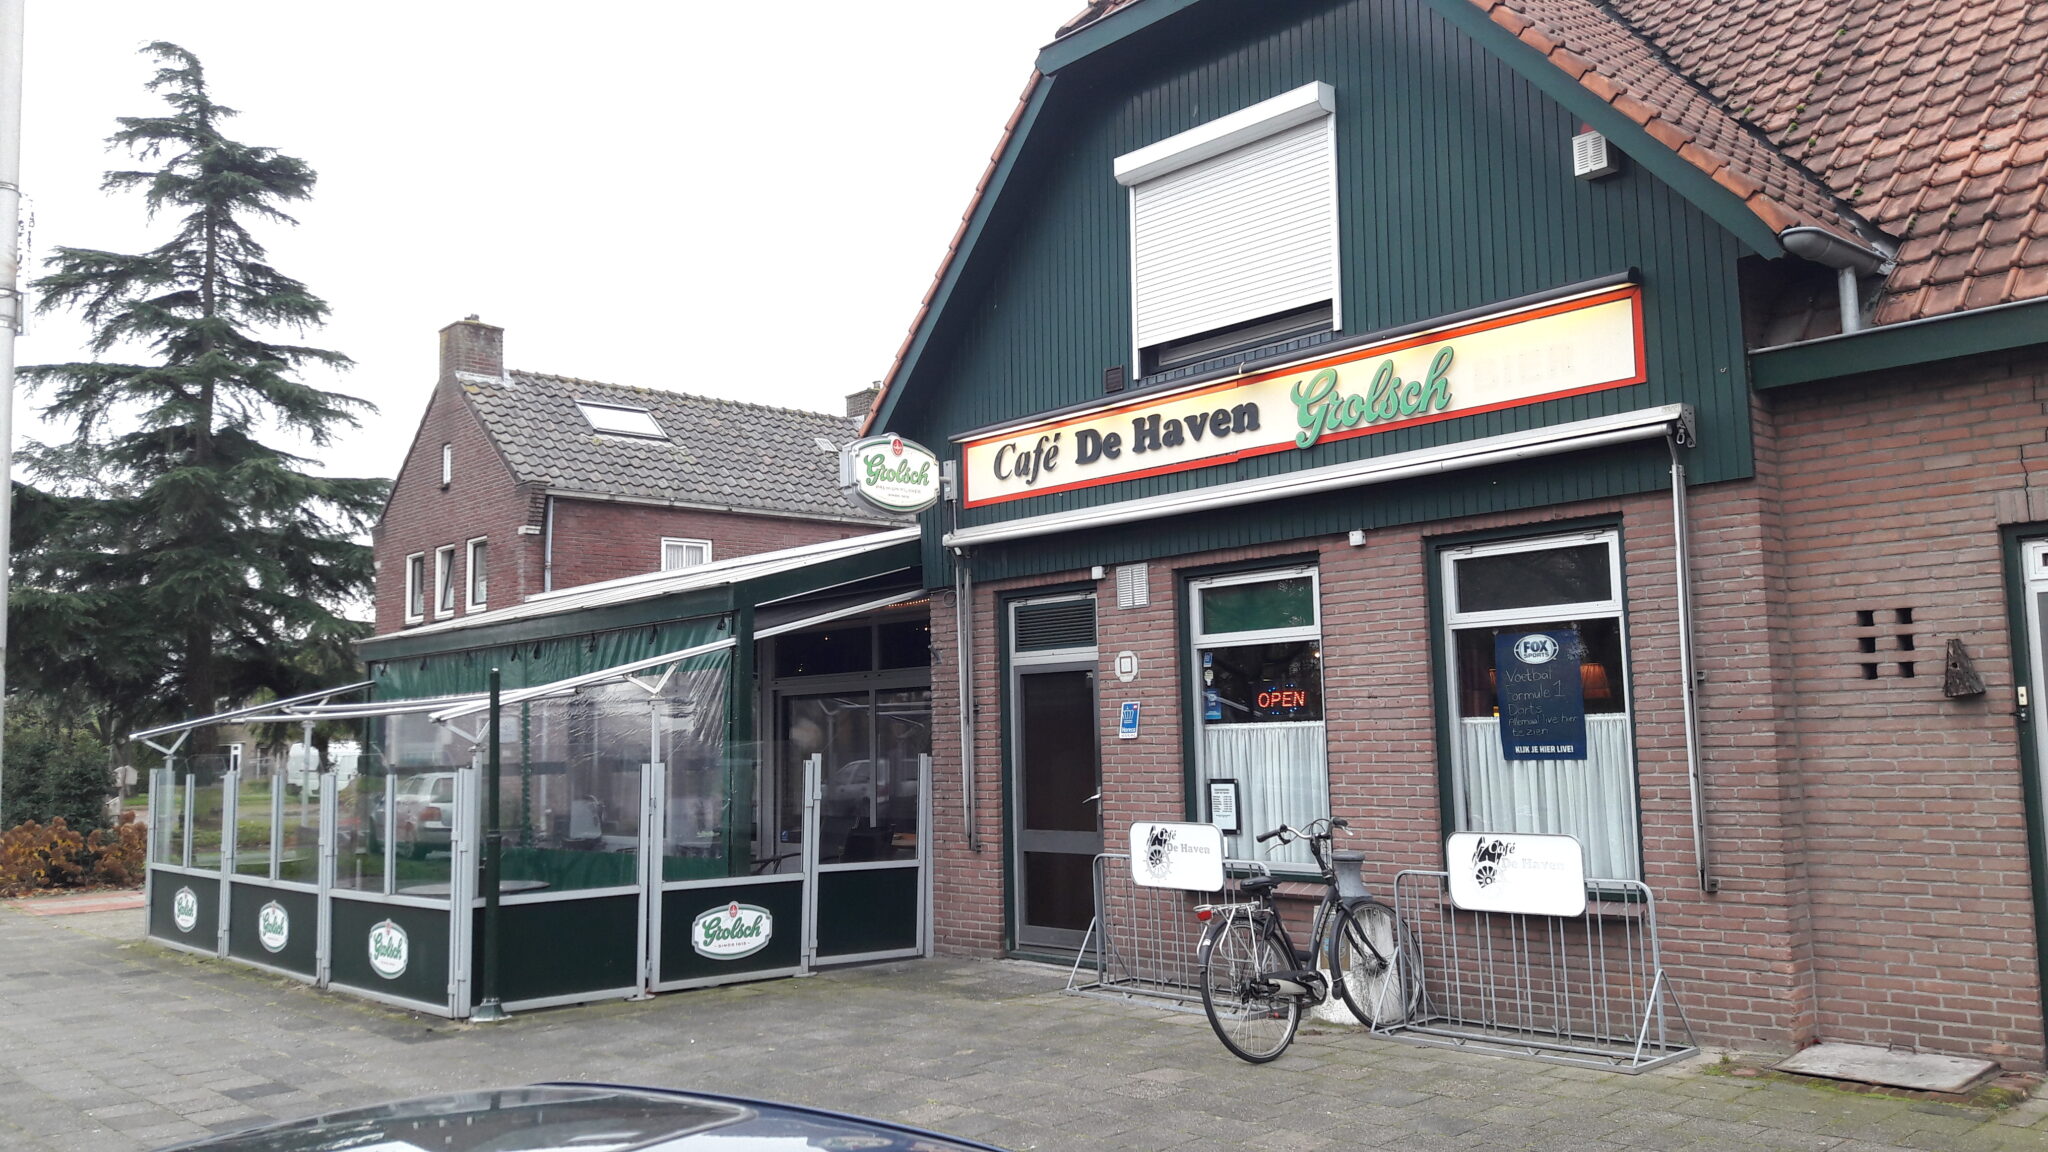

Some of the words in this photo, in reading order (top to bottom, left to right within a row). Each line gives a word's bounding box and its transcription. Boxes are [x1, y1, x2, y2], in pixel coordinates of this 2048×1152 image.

[1290, 345, 1454, 449] Grolsch
[993, 432, 1062, 485] Café
[1075, 428, 1122, 465] De
[1132, 402, 1261, 453] Haven
[863, 453, 931, 487] Grolsch
[1523, 640, 1549, 653] FOX
[1506, 666, 1552, 682] Voetbal
[1506, 684, 1551, 701] Formule
[1553, 679, 1566, 697] 1
[1258, 691, 1305, 708] OPEN
[1508, 702, 1543, 716] Darts
[1515, 745, 1530, 754] KIJK
[1531, 745, 1539, 754] JE
[1540, 745, 1556, 753] HIER
[1557, 745, 1574, 753] LIVE!
[1158, 828, 1177, 842] Café
[1166, 842, 1179, 852] De
[1181, 843, 1211, 855] Haven
[1489, 841, 1516, 857] Café
[702, 914, 763, 947] Grolsch
[374, 932, 403, 961] Grolsch
